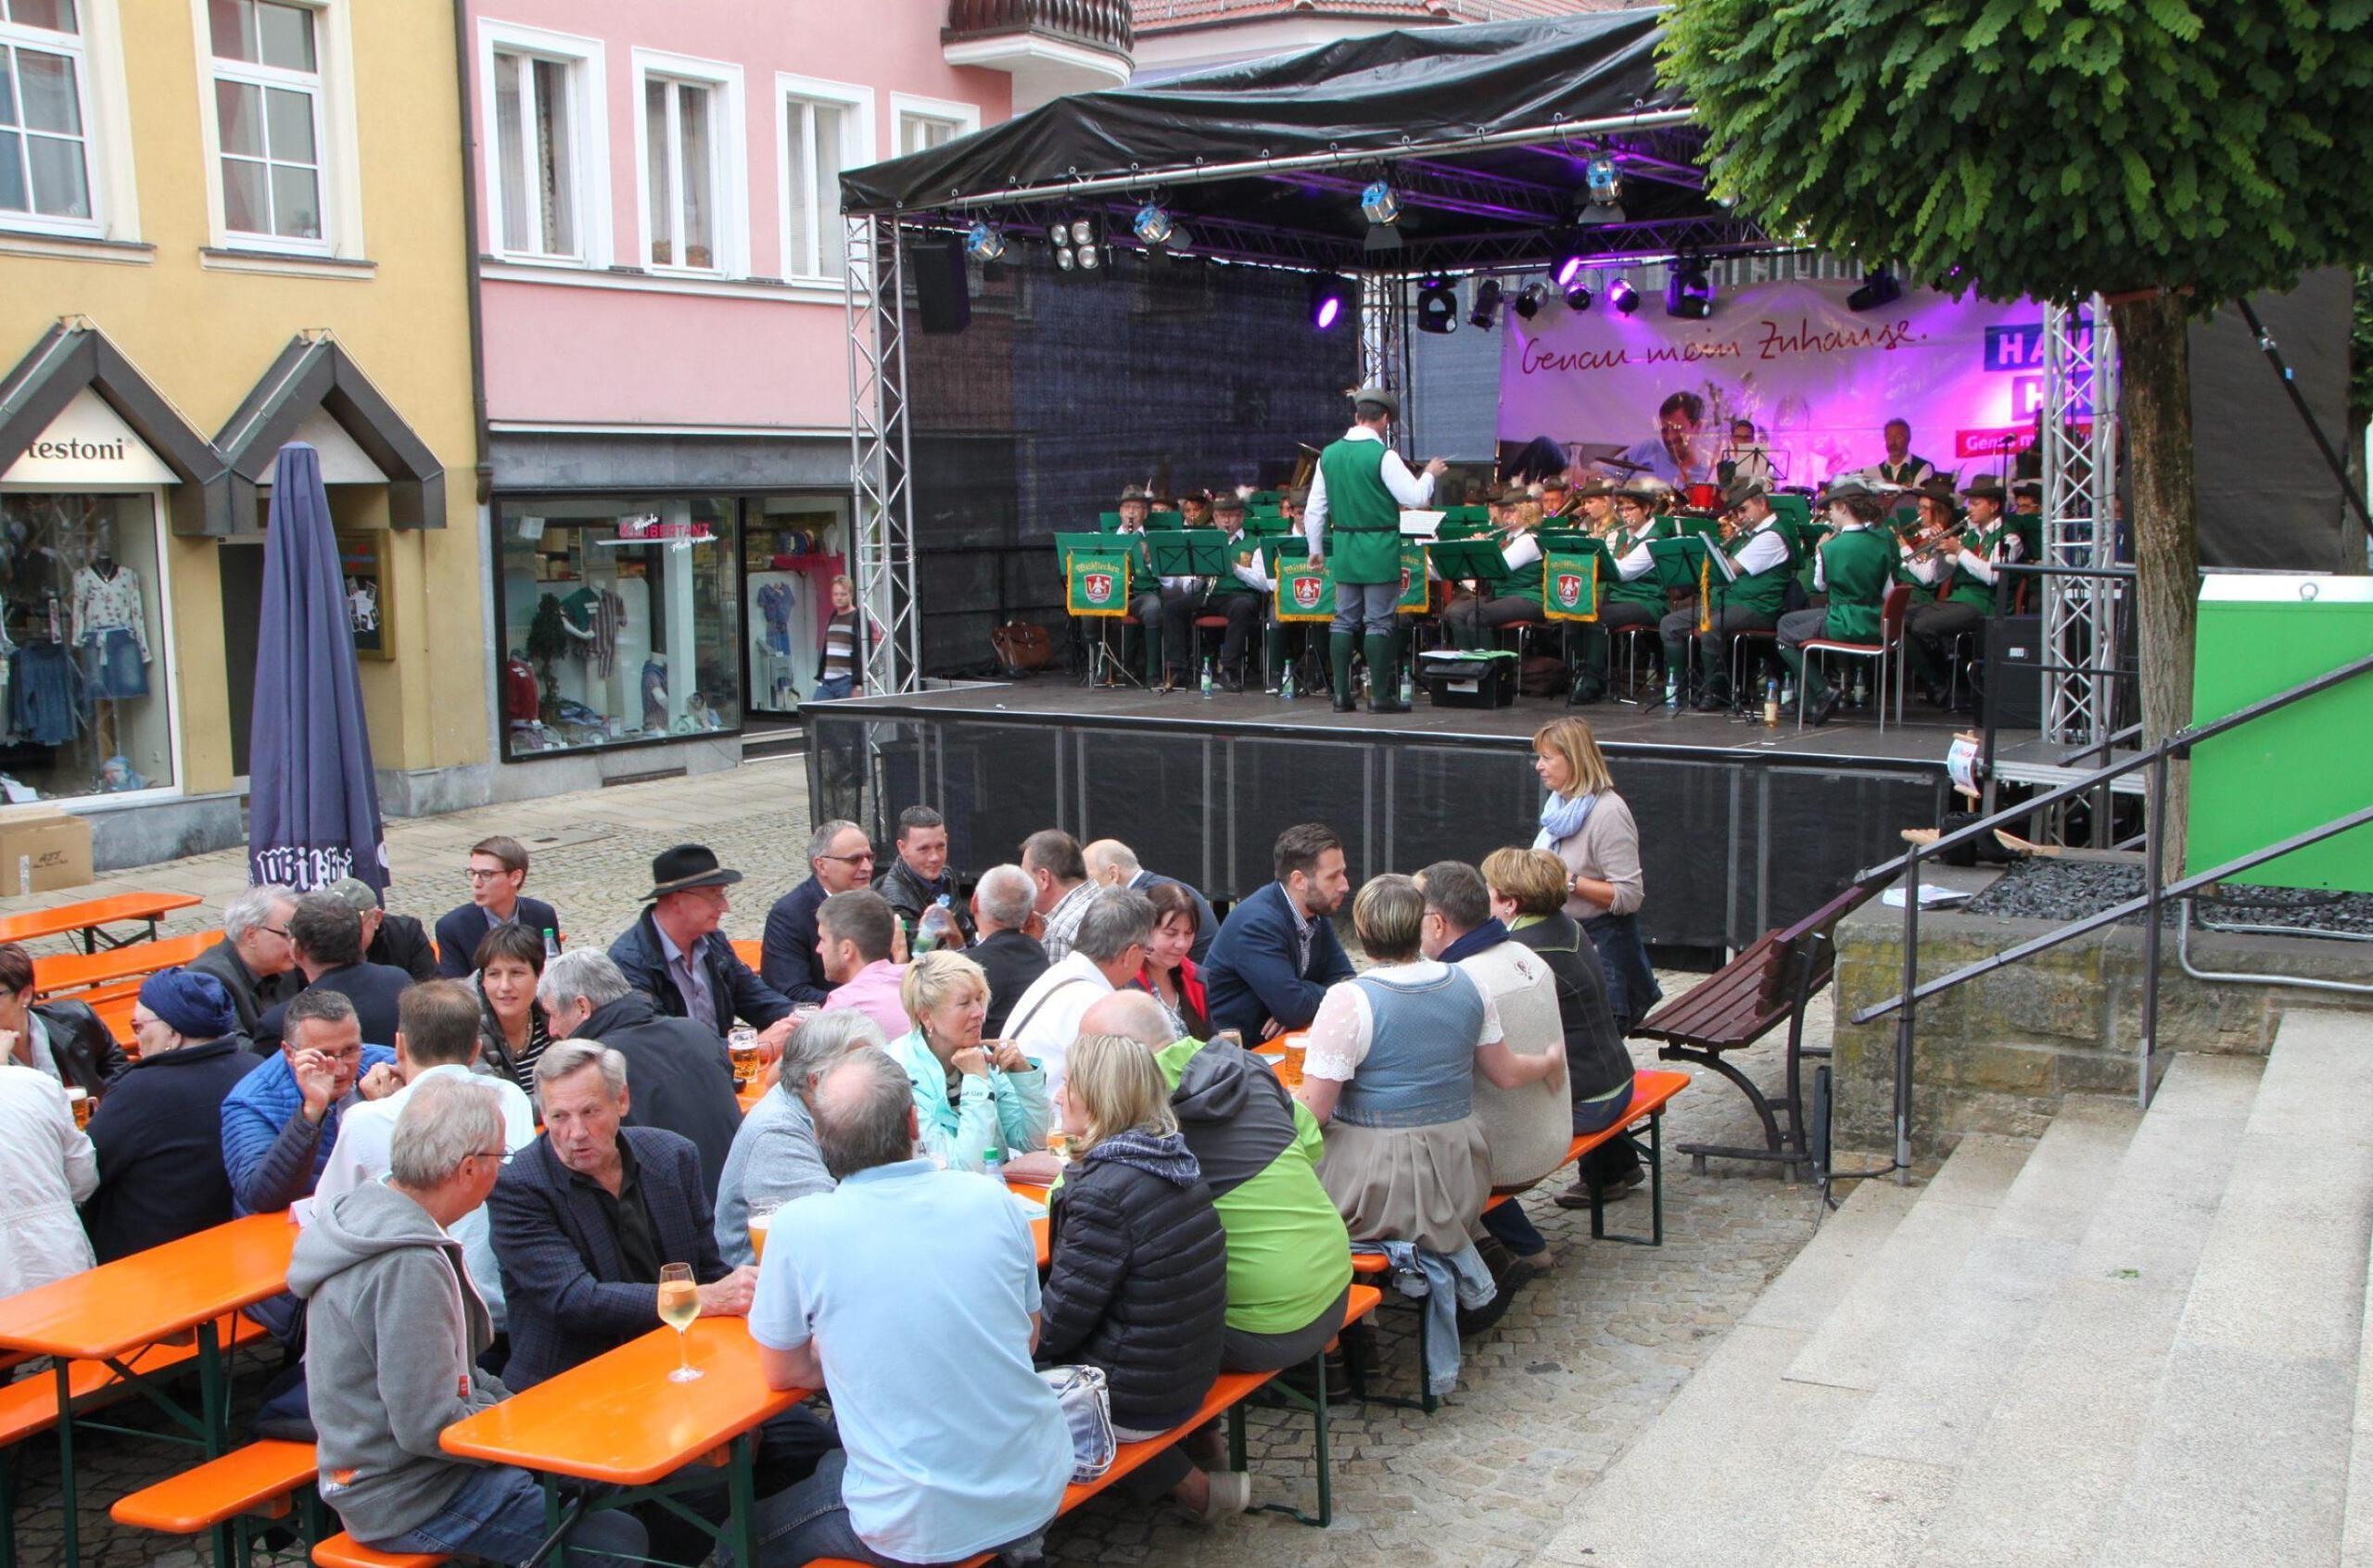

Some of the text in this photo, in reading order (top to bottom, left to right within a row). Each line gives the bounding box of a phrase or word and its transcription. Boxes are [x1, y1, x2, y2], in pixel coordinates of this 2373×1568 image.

[1522, 318, 1928, 374] Genau mein Zuhause.
